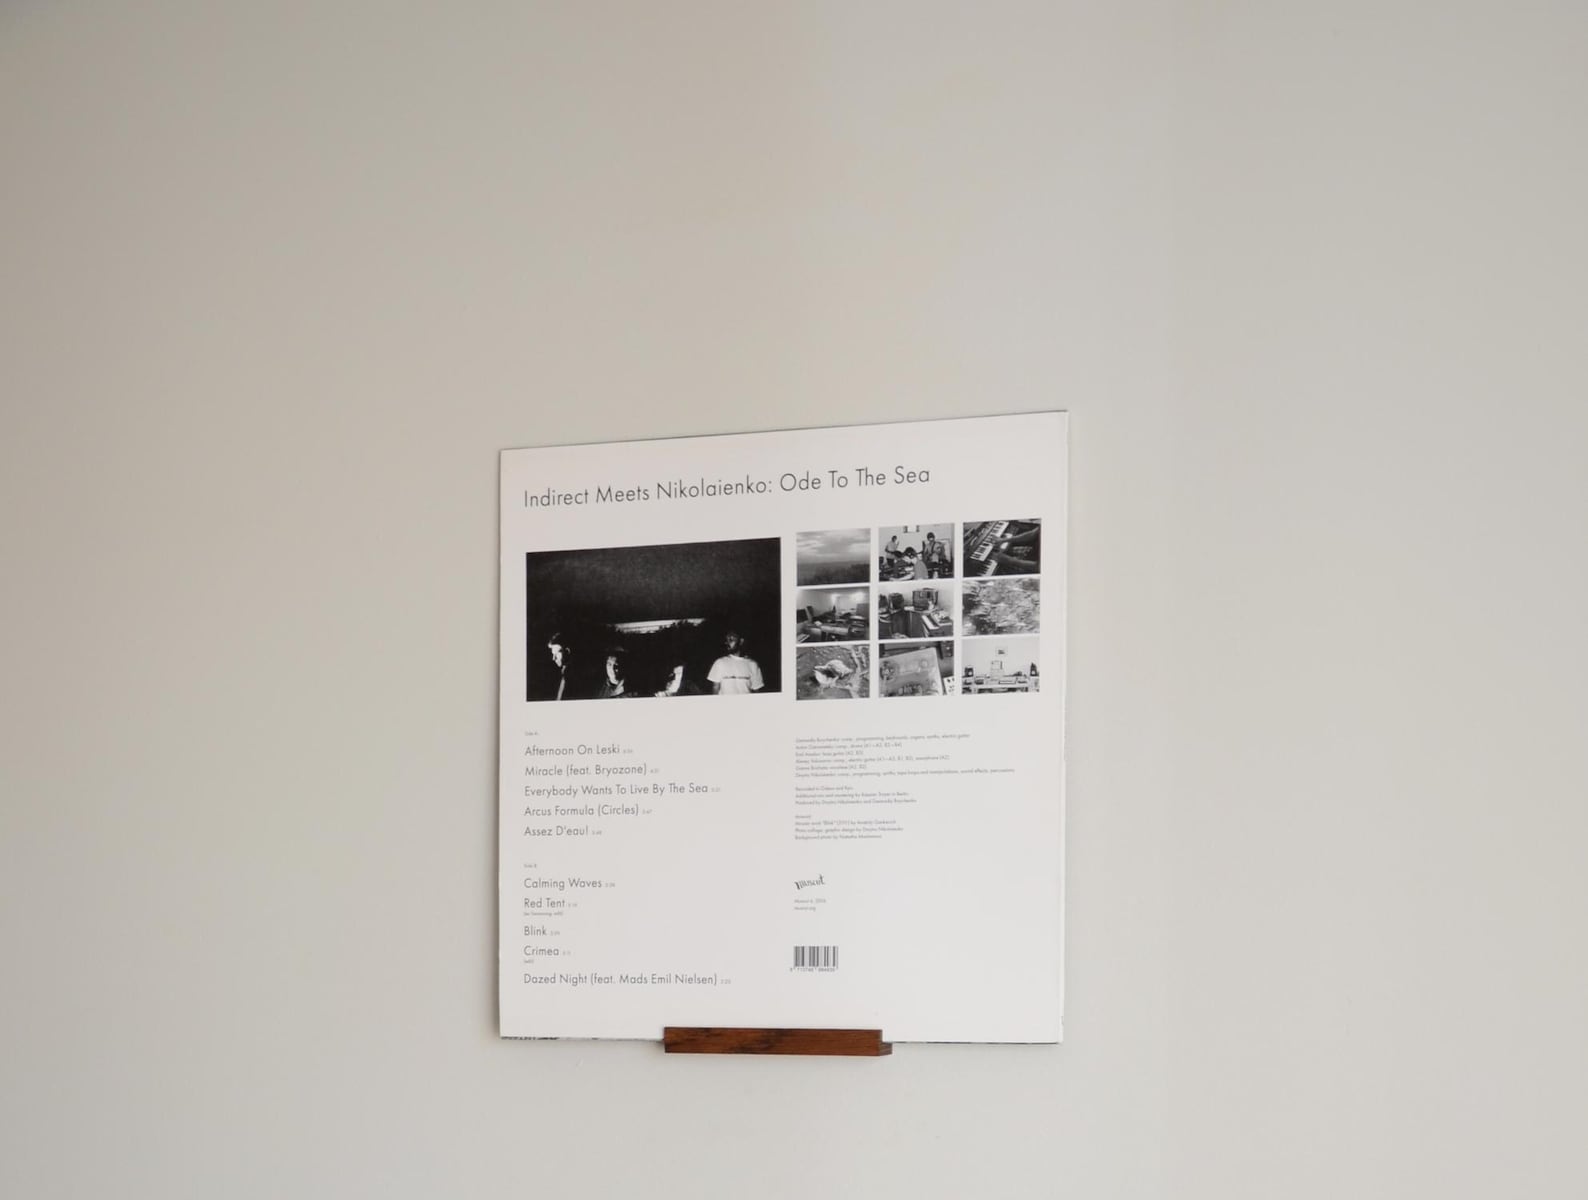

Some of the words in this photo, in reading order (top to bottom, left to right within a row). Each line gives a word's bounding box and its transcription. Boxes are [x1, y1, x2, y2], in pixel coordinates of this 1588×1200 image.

[525, 488, 589, 507] Indirect
[596, 485, 649, 504] Meets
[657, 474, 772, 500] Nikolaienko:
[780, 470, 821, 491] Ode
[828, 470, 848, 488] To
[855, 466, 886, 486] The
[894, 465, 930, 484] Sea
[525, 745, 574, 756] Afternoon
[577, 744, 592, 756] On
[597, 744, 620, 755] Leski
[525, 765, 562, 776] Miracle
[525, 785, 578, 798] Everybody
[581, 785, 612, 795] Wants
[616, 784, 626, 794] To
[630, 784, 649, 794] Live
[653, 784, 665, 796] By
[668, 783, 685, 793] The
[689, 782, 708, 793] Sea
[524, 807, 551, 817] Arcus
[555, 805, 594, 816] Formula
[524, 827, 552, 837] Assez
[524, 878, 565, 891] Calming
[568, 878, 602, 888] Waves
[524, 898, 542, 908] Red
[546, 898, 565, 908] Tent
[524, 925, 546, 936] Blink
[524, 945, 559, 956] Crimea
[524, 973, 556, 984] Dazed
[560, 973, 587, 986] Night
[619, 973, 647, 984] Mads
[651, 973, 671, 984] Emil
